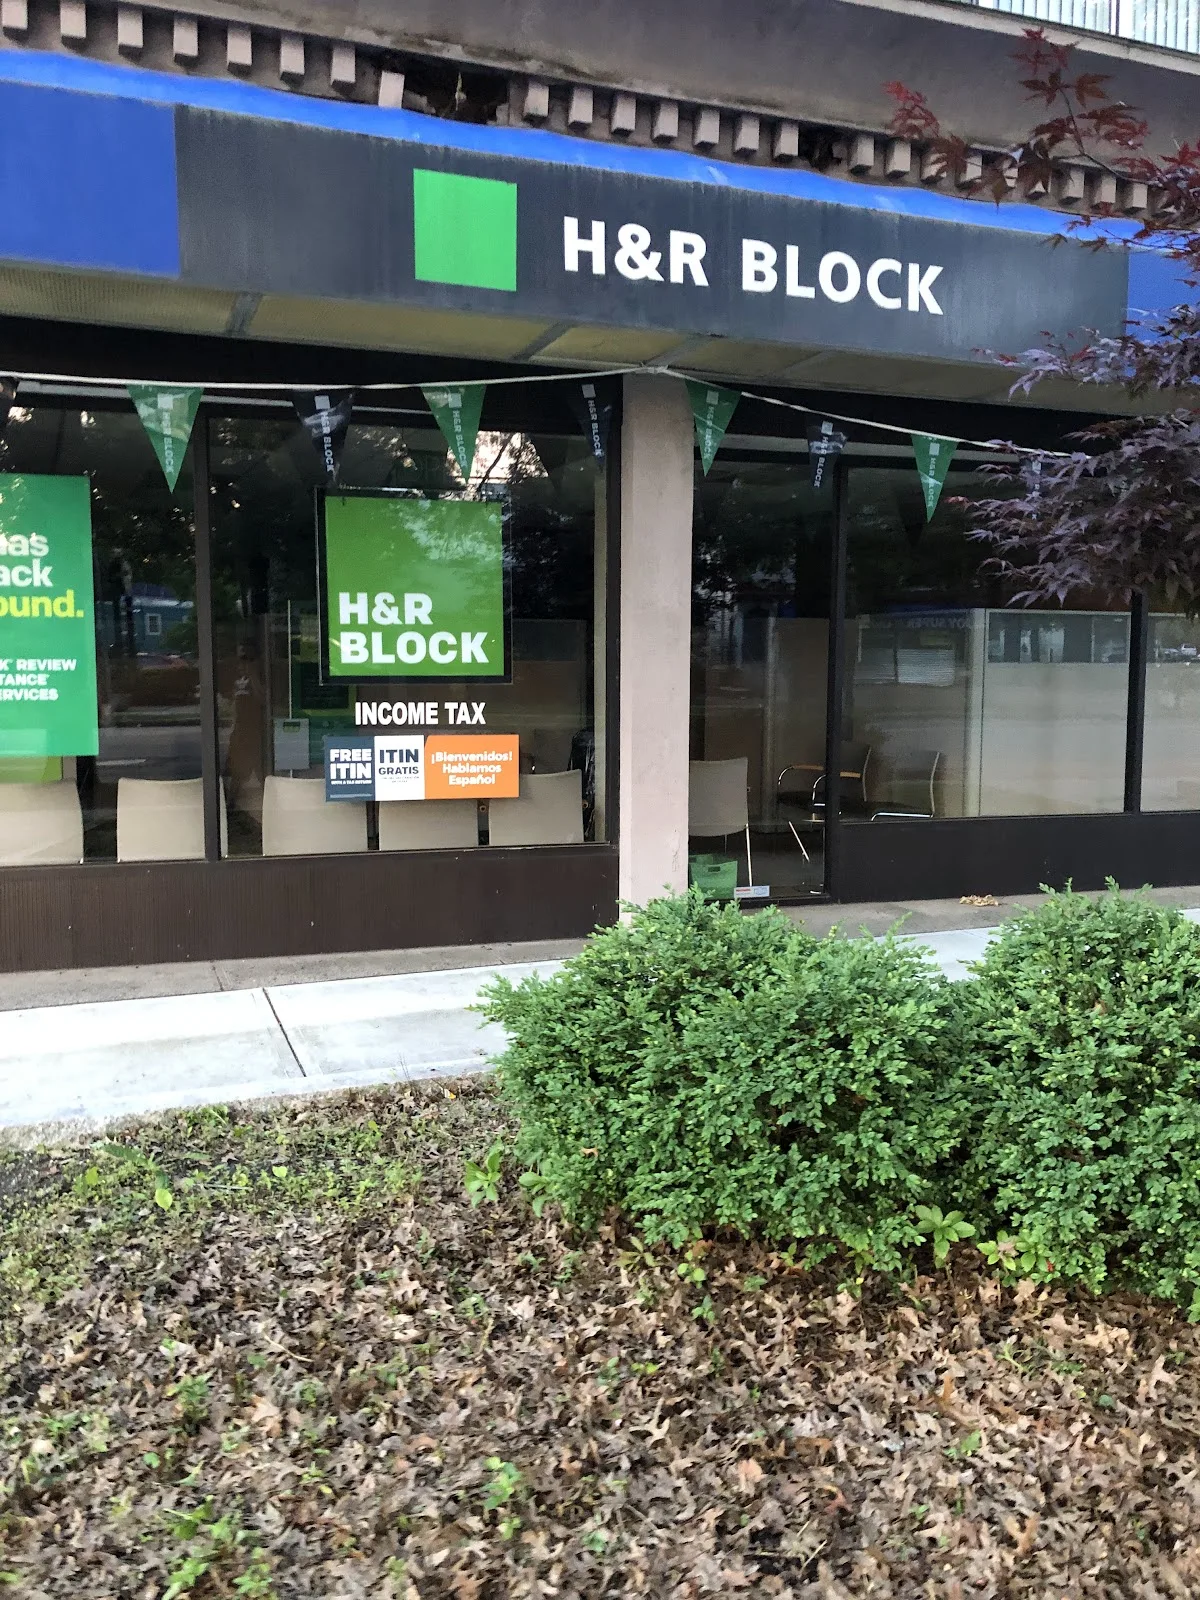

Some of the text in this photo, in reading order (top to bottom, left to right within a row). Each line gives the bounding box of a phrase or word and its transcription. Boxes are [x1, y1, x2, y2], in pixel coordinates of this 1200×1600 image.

[563, 215, 944, 316] H&R BLOCK
[456, 434, 468, 468] BLOCK
[591, 422, 605, 458] BLOCK
[703, 428, 713, 459] BLOCK
[163, 437, 174, 474] BLOCK
[323, 436, 335, 473] BLOCK
[814, 456, 826, 488] BLOCK
[338, 592, 433, 626] H&R
[340, 631, 489, 664] BLOCK
[16, 658, 77, 671] REVIEW
[355, 702, 486, 725] INCOME TAX
[329, 748, 372, 762] FREE
[380, 749, 419, 763] ITIN
[431, 751, 512, 764] ¡Bienvenidos!
[442, 763, 502, 774] Hablamos
[329, 763, 372, 780] ITIN
[378, 766, 419, 775] GRATIS
[448, 774, 496, 787] Español
